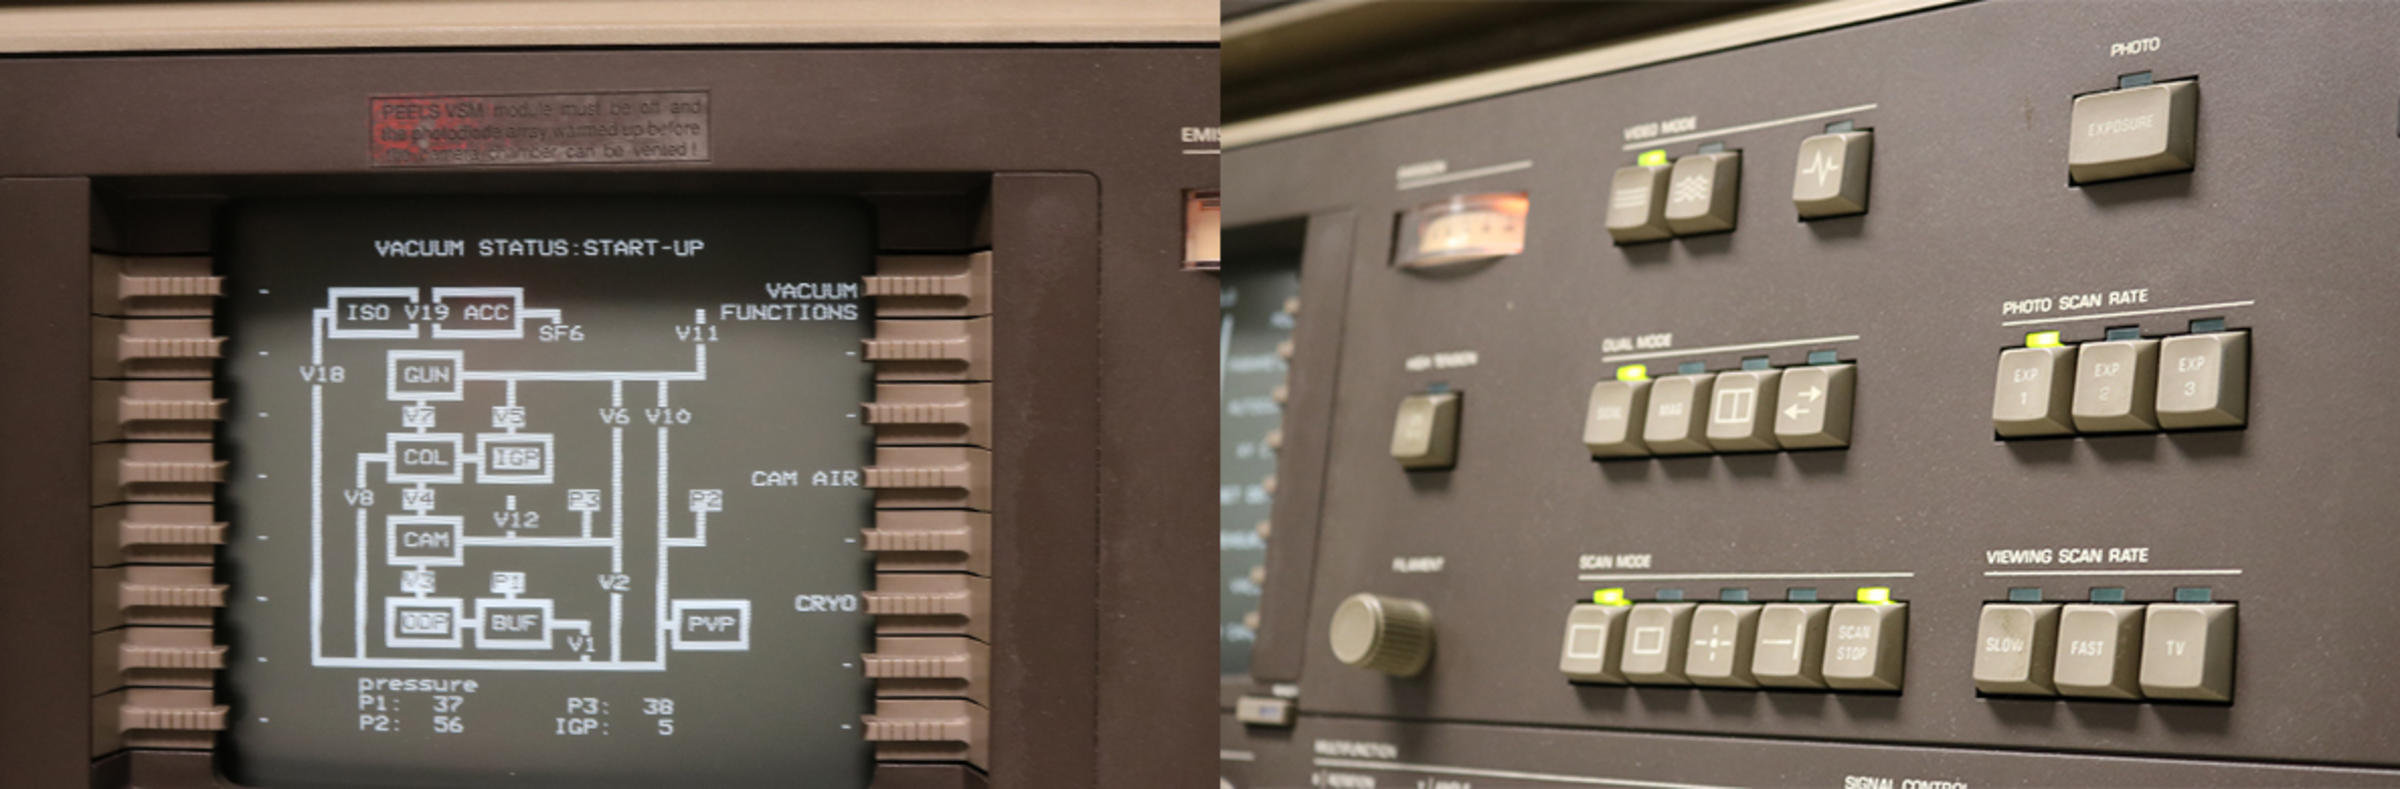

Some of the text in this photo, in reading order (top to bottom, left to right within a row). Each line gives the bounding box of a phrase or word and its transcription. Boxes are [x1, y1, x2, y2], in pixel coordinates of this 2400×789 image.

[2110, 37, 2160, 57] PHOTO
[382, 103, 440, 119] PEELS
[445, 102, 485, 118] VSM
[494, 101, 549, 117] module
[560, 101, 599, 116] must
[610, 100, 632, 115] be
[670, 99, 700, 114] and
[505, 125, 546, 143] array
[622, 124, 645, 140] up
[648, 120, 700, 136] before
[1661, 115, 1697, 134] MODE
[2088, 114, 2154, 136] EXPOSURE
[566, 146, 596, 159] can
[604, 144, 625, 158] be
[375, 239, 705, 256] VACUUM STATUS:START-UP
[766, 283, 858, 299] VACUUM
[2003, 289, 2149, 315] PHOTO SCAN RATE
[347, 304, 510, 321] ISO V19 ACC
[720, 303, 858, 320] FUNCTIONS
[538, 325, 584, 342] SF6
[675, 325, 719, 341] V11
[1602, 333, 1673, 352] DUAL MODE
[2094, 362, 2120, 377] EXP
[2178, 357, 2205, 372] EXP
[299, 365, 345, 383] V18
[404, 366, 450, 383] GUN
[2014, 368, 2039, 383] EXP
[2099, 387, 2111, 401] 2
[2184, 381, 2196, 396] 3
[2020, 391, 2028, 405] 1
[402, 406, 435, 428] V7
[493, 406, 525, 428] V5
[600, 408, 630, 424] V6
[645, 408, 692, 425] V10
[404, 449, 449, 465] COL
[493, 448, 540, 469] IGP
[751, 471, 859, 487] CAM AIR
[344, 489, 374, 506] V8
[402, 489, 435, 510] V4
[568, 489, 600, 511] P3
[689, 490, 722, 511] P2
[493, 511, 539, 528] V12
[404, 532, 449, 548] CAM
[1579, 554, 1652, 569] SCAN MODE
[1986, 547, 2149, 565] VIEWING SCAN RATE
[490, 572, 525, 593] P1
[598, 574, 630, 592] V2
[794, 594, 857, 612] CRYO
[491, 614, 538, 631] BUF
[688, 616, 735, 632] PVP
[1838, 625, 1871, 640] SCAN
[567, 636, 595, 652] V1
[1985, 637, 2024, 652] SLOW
[2070, 641, 2104, 656] FAST
[2166, 641, 2185, 655] TV
[1836, 647, 1869, 661] STOP
[358, 677, 479, 693] pressure
[358, 695, 464, 713] P1: 37
[567, 698, 674, 715] P3: 38
[359, 715, 464, 734] P2: 56
[556, 718, 674, 736] IGP: 5
